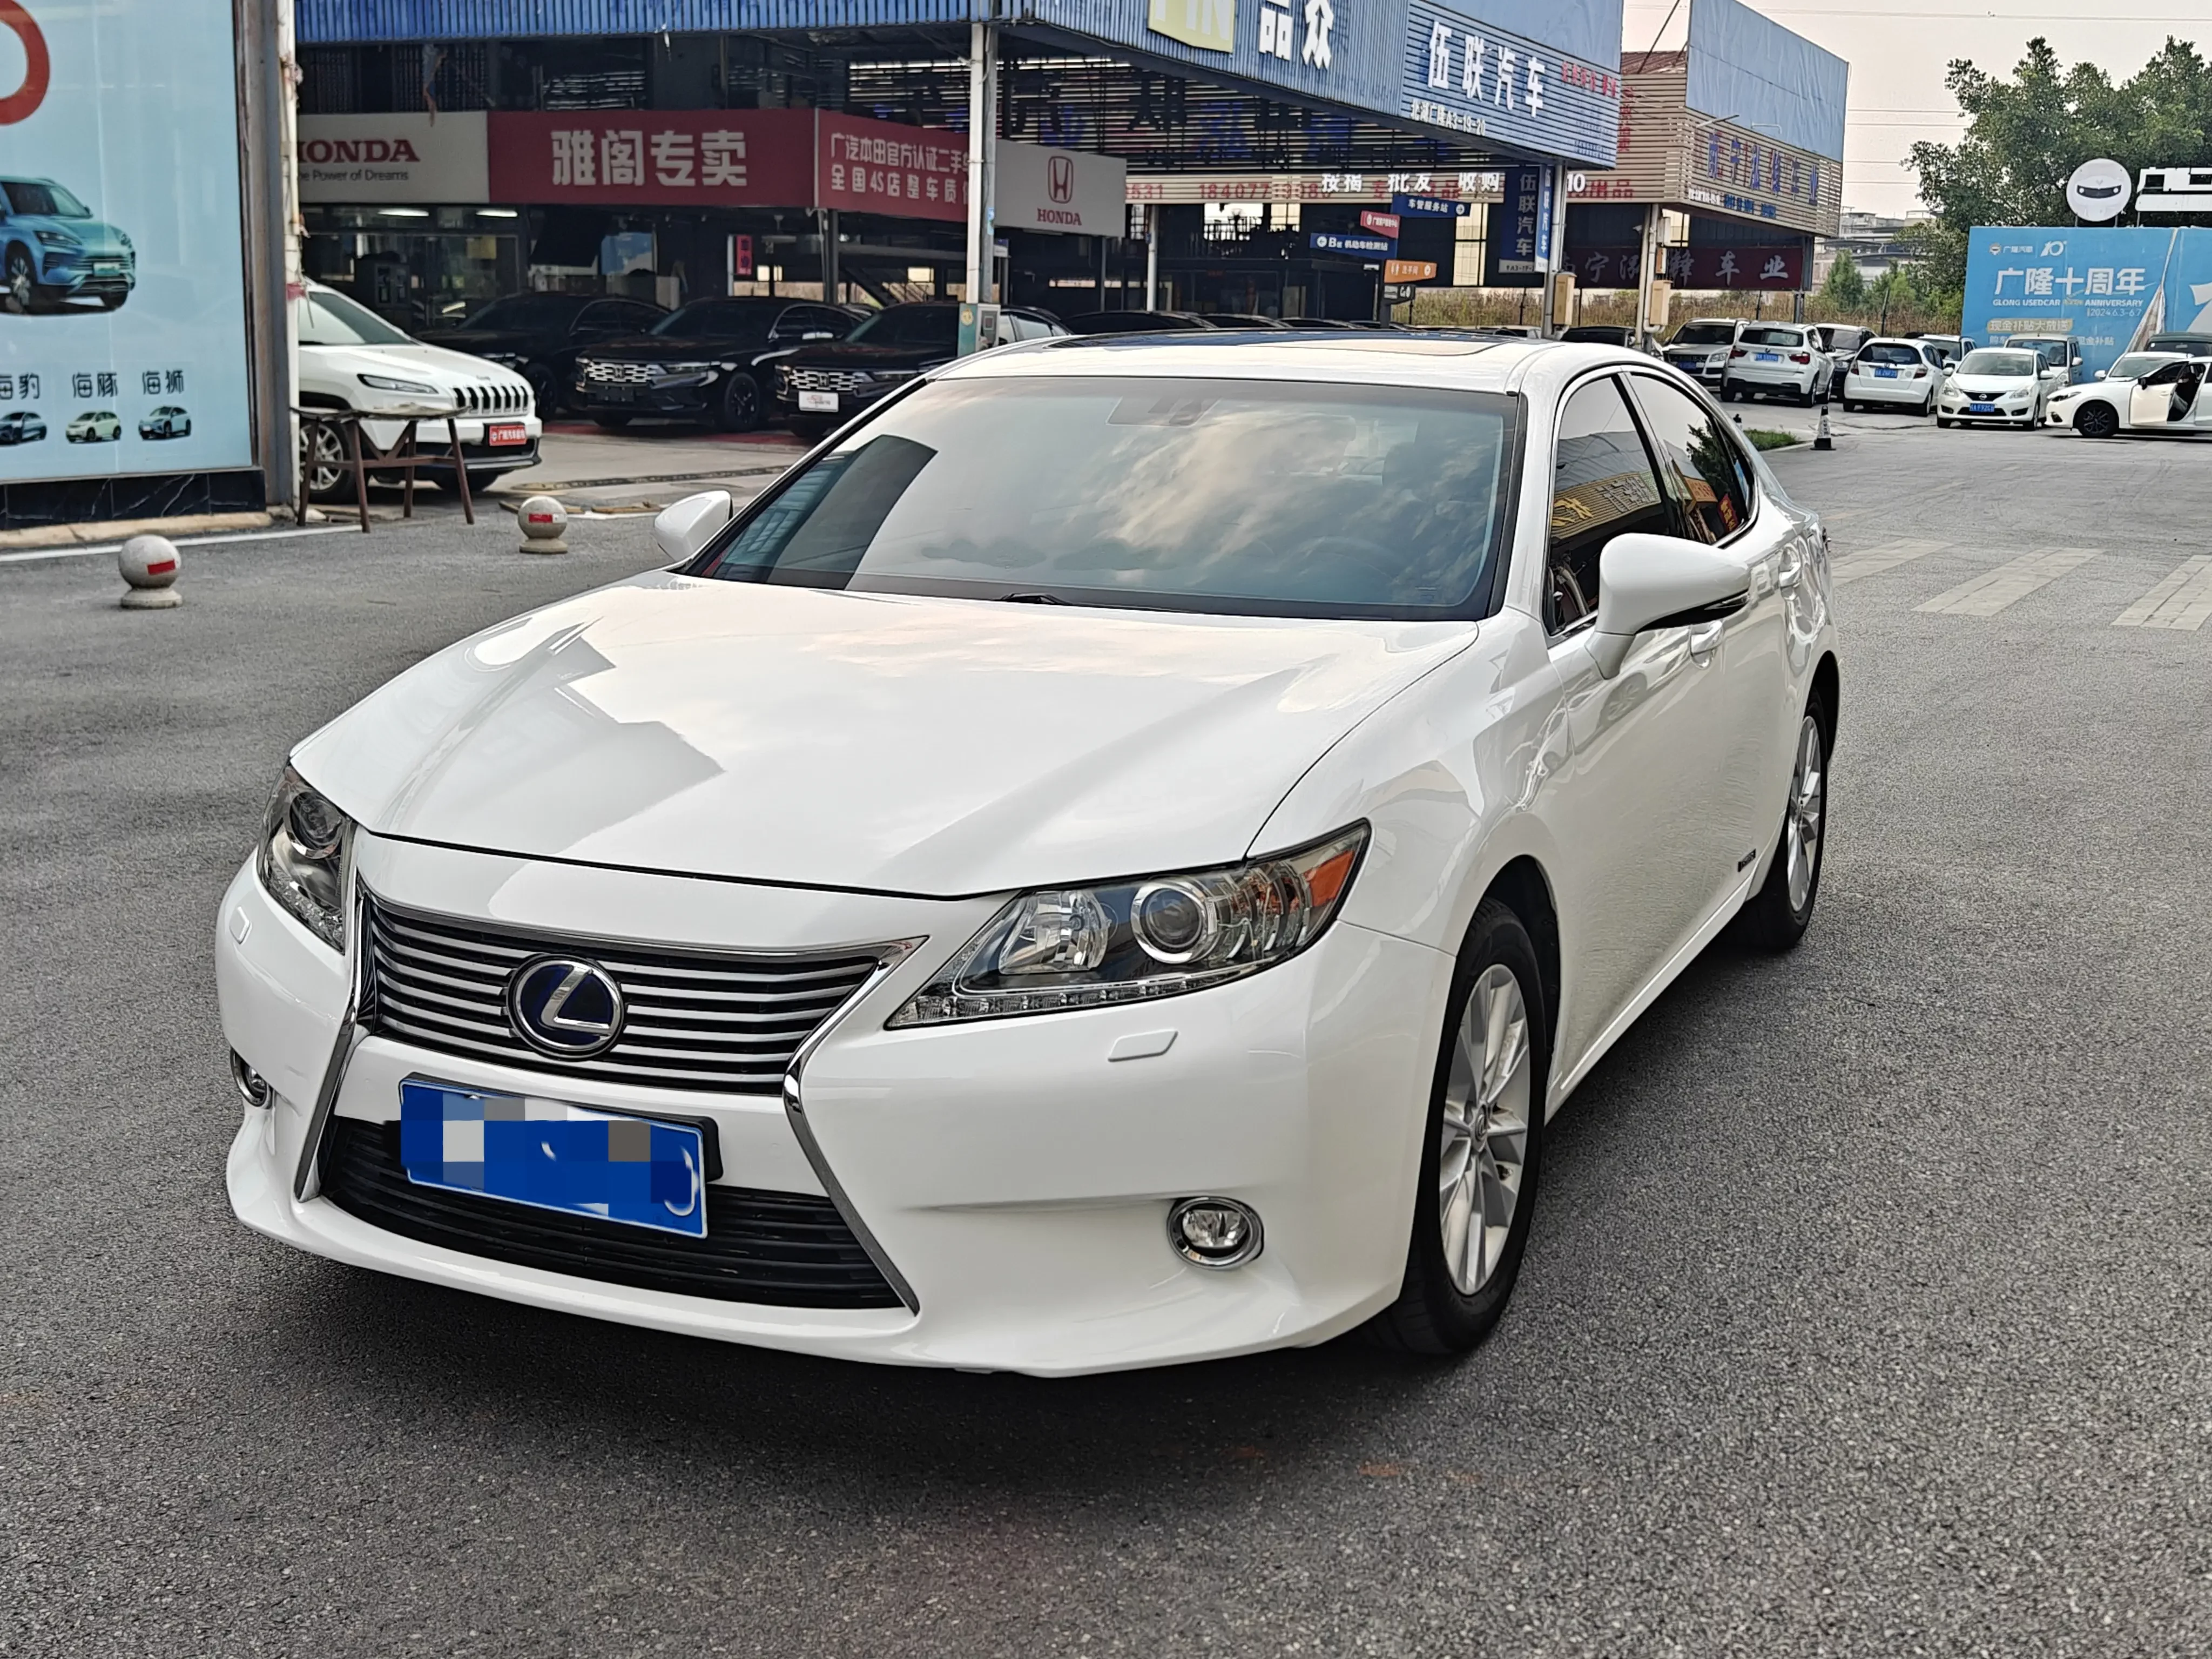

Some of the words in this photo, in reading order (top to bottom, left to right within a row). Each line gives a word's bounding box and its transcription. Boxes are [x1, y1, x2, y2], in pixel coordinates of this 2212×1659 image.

[1428, 22, 1545, 118] 伍联汽车
[550, 130, 747, 186] 雅阁专卖
[313, 169, 348, 181] Power
[350, 168, 362, 181] of
[365, 169, 409, 181] Dreams
[1037, 208, 1082, 226] HONDA
[1408, 198, 1448, 213] 车管服务站
[1515, 173, 1537, 257] 伍联汽车
[1994, 267, 2146, 295] 广隆十周年
[2085, 299, 2144, 307] ANNIVERSARY
[1990, 320, 2071, 332] 现金补贴大放送
[72, 372, 118, 398] 海豚
[142, 369, 184, 395] 海狮
